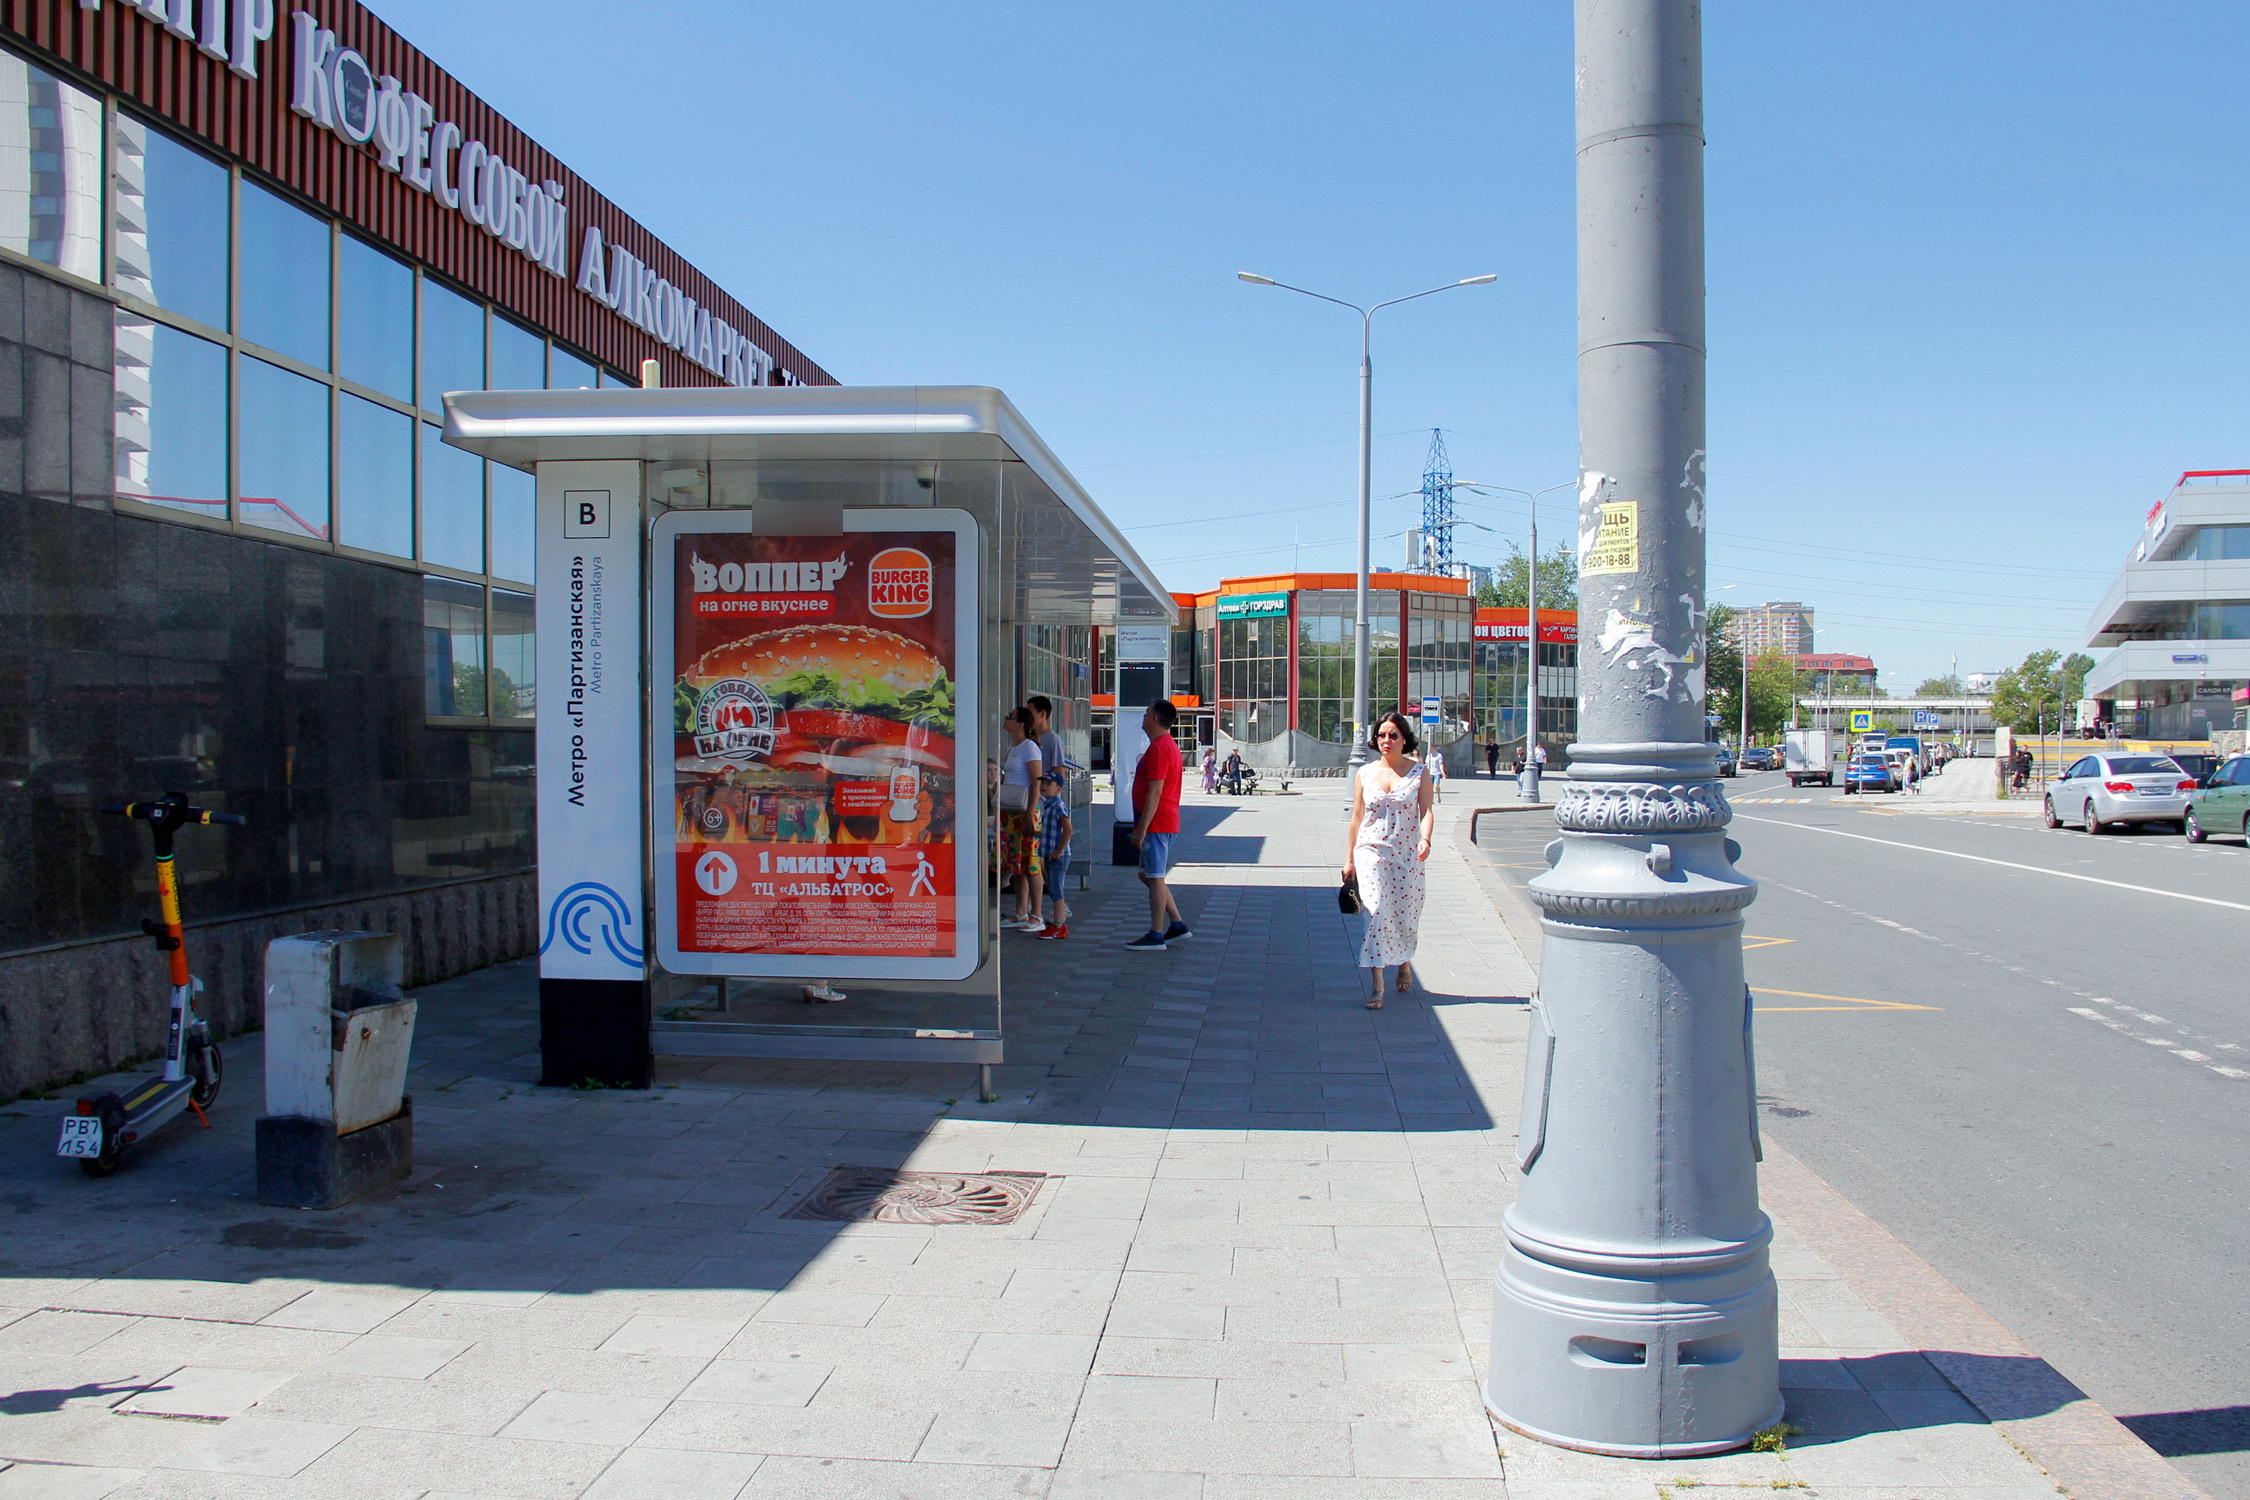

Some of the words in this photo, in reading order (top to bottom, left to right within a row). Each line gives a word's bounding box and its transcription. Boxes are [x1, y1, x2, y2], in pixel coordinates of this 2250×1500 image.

[576, 226, 773, 387] АЛКОМАРКЕТ
[690, 552, 848, 592] ВОППЕР
[871, 570, 929, 584] BURGER
[590, 556, 604, 649] Partizanskaya
[871, 584, 930, 604] KING
[699, 601, 719, 612] на
[722, 601, 759, 613] огне
[761, 600, 829, 615] вкуснее
[1218, 604, 1240, 613] Аптеки
[1250, 600, 1285, 611] ГОРЗДРАВ
[567, 555, 588, 728] «Партизанская»
[1490, 625, 1530, 639] ЦВЕТОВ
[590, 653, 602, 694] Metro
[700, 696, 716, 728] 100%
[713, 683, 769, 724] ГОВЯДИНА
[699, 736, 725, 754] НА
[727, 732, 771, 750] ОГНЕ
[567, 734, 588, 807] Метро
[894, 787, 916, 795] KING
[707, 812, 721, 822] 6+
[758, 851, 770, 873] 1
[776, 856, 887, 880] минута
[752, 883, 775, 897] ТЦ
[779, 883, 894, 896] «АЛЬБАТРОС»
[57, 1140, 98, 1155] 154
